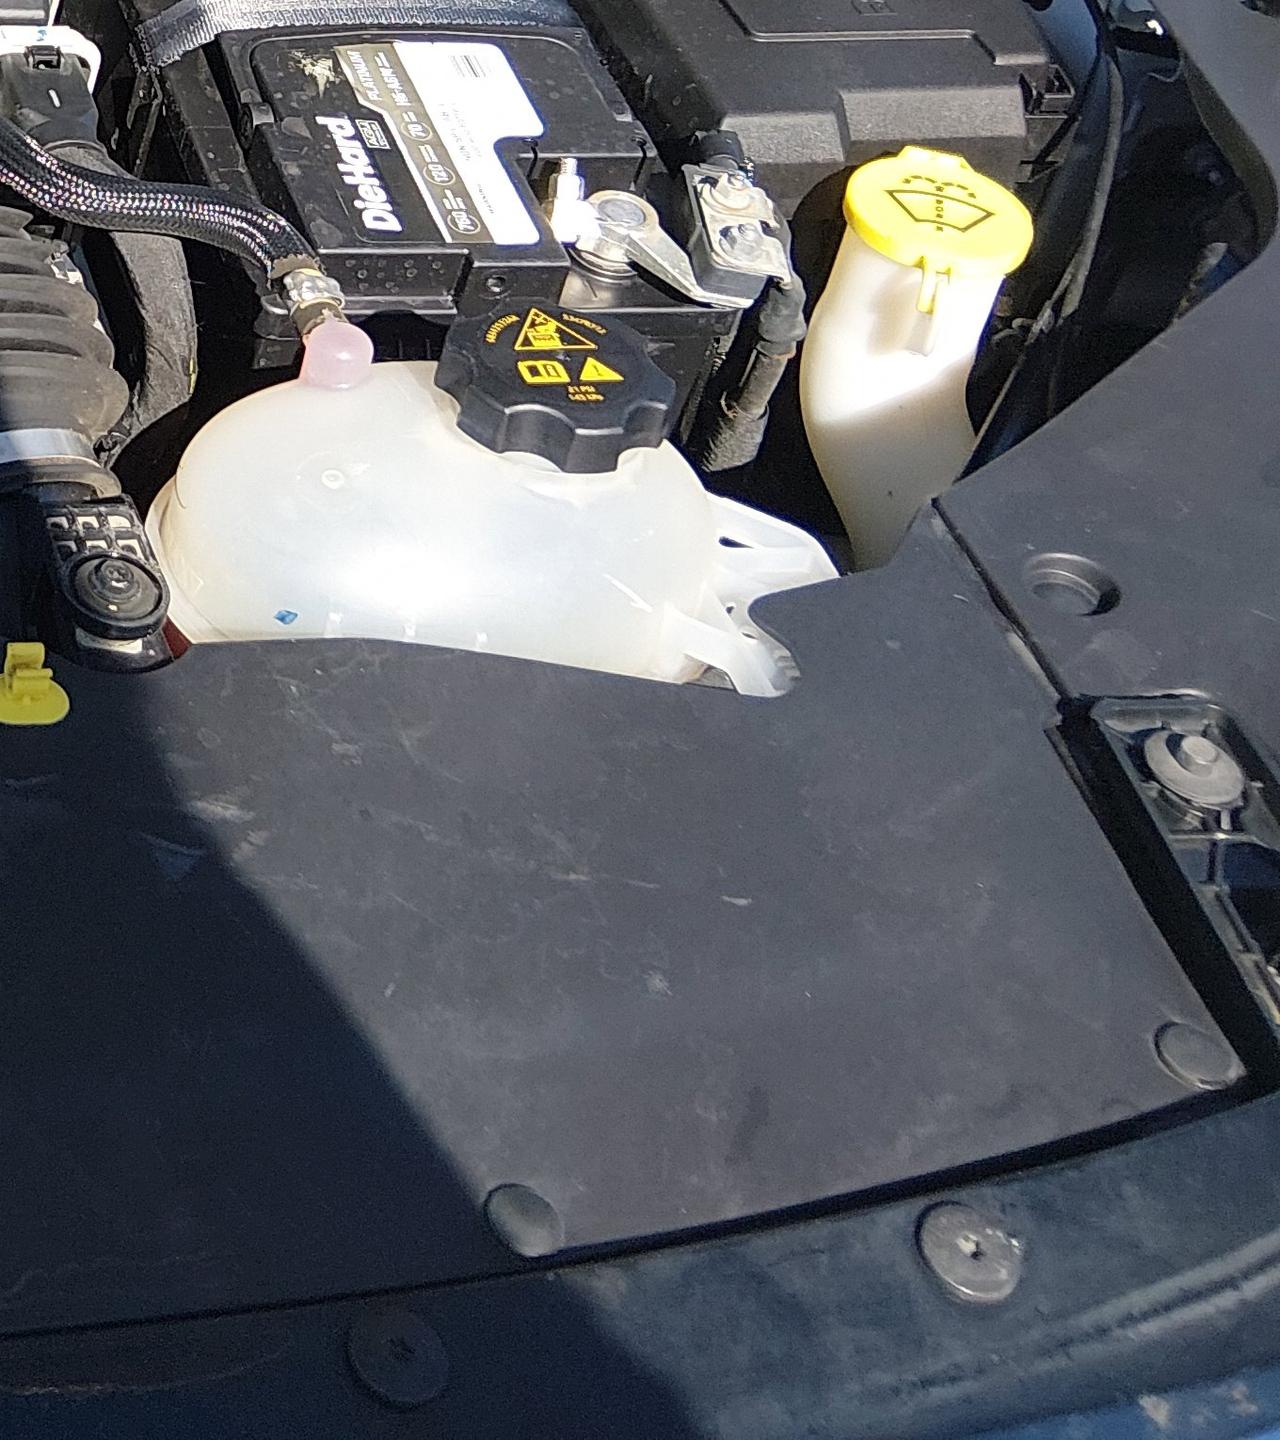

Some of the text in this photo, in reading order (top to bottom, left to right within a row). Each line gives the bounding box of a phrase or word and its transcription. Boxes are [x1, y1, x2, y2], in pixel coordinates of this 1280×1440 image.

[347, 50, 383, 101] PLATINUM
[407, 121, 428, 138] 70
[315, 114, 403, 232] DieHard
[427, 162, 450, 183] 120
